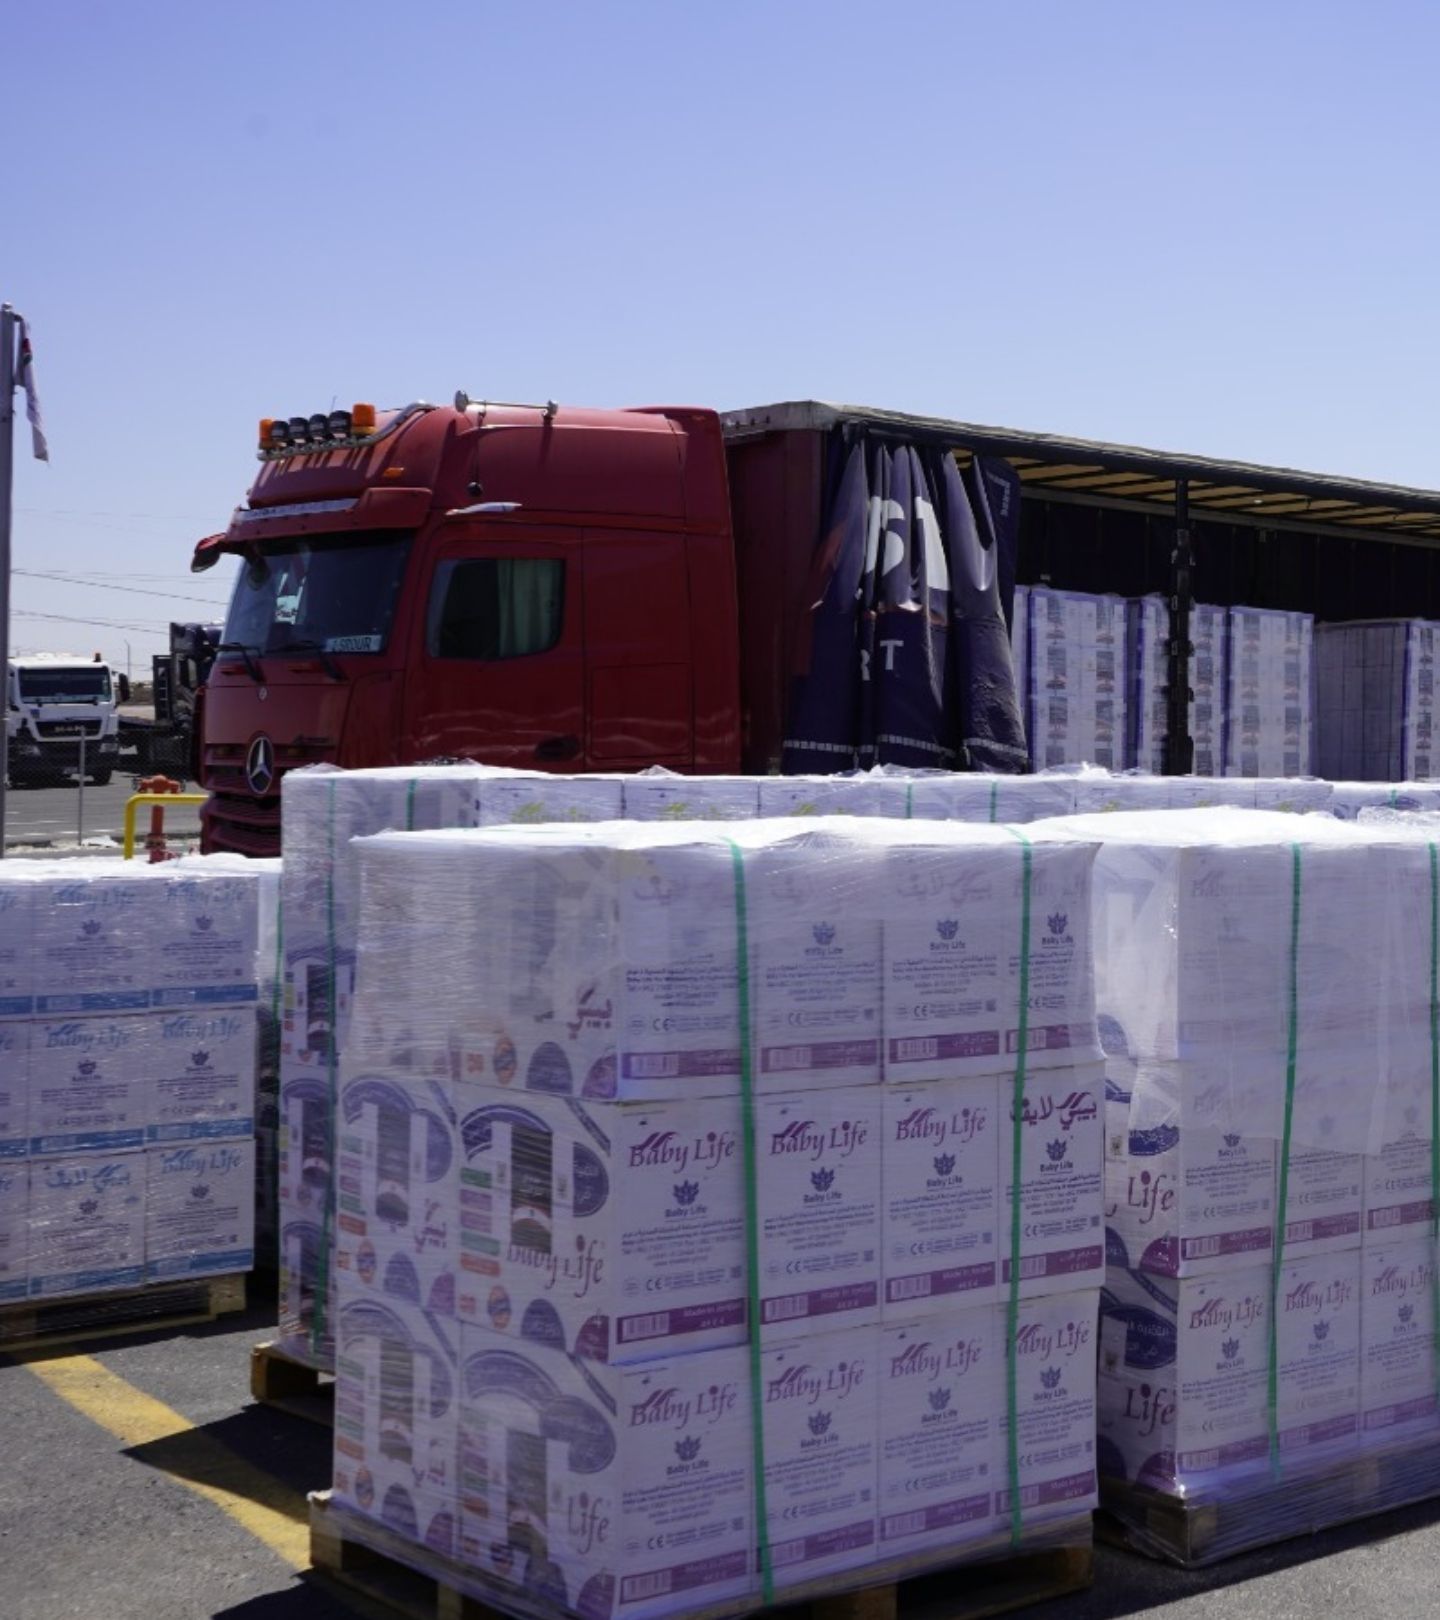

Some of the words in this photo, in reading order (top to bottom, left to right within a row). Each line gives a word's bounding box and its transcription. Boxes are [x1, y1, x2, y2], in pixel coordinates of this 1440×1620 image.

[769, 1120, 825, 1161] Baby
[829, 1120, 868, 1158] Life
[895, 1107, 946, 1147] Baby
[951, 1107, 987, 1144] Life
[628, 1131, 688, 1174] Baby
[693, 1131, 737, 1170] Life
[1128, 1170, 1176, 1225] Life
[562, 1234, 605, 1299] Life
[1189, 1297, 1232, 1333] Baby
[1236, 1295, 1265, 1329] Life
[1285, 1281, 1324, 1315] Baby
[1327, 1279, 1353, 1311] Life
[889, 1341, 941, 1381] Baby
[945, 1337, 983, 1376] Life
[1056, 1321, 1091, 1357] Life
[766, 1364, 822, 1405] Baby
[826, 1360, 866, 1399] Life
[629, 1387, 691, 1429] Baby
[696, 1383, 738, 1424] Life
[1123, 1382, 1177, 1437] Life
[567, 1491, 610, 1555] Life
